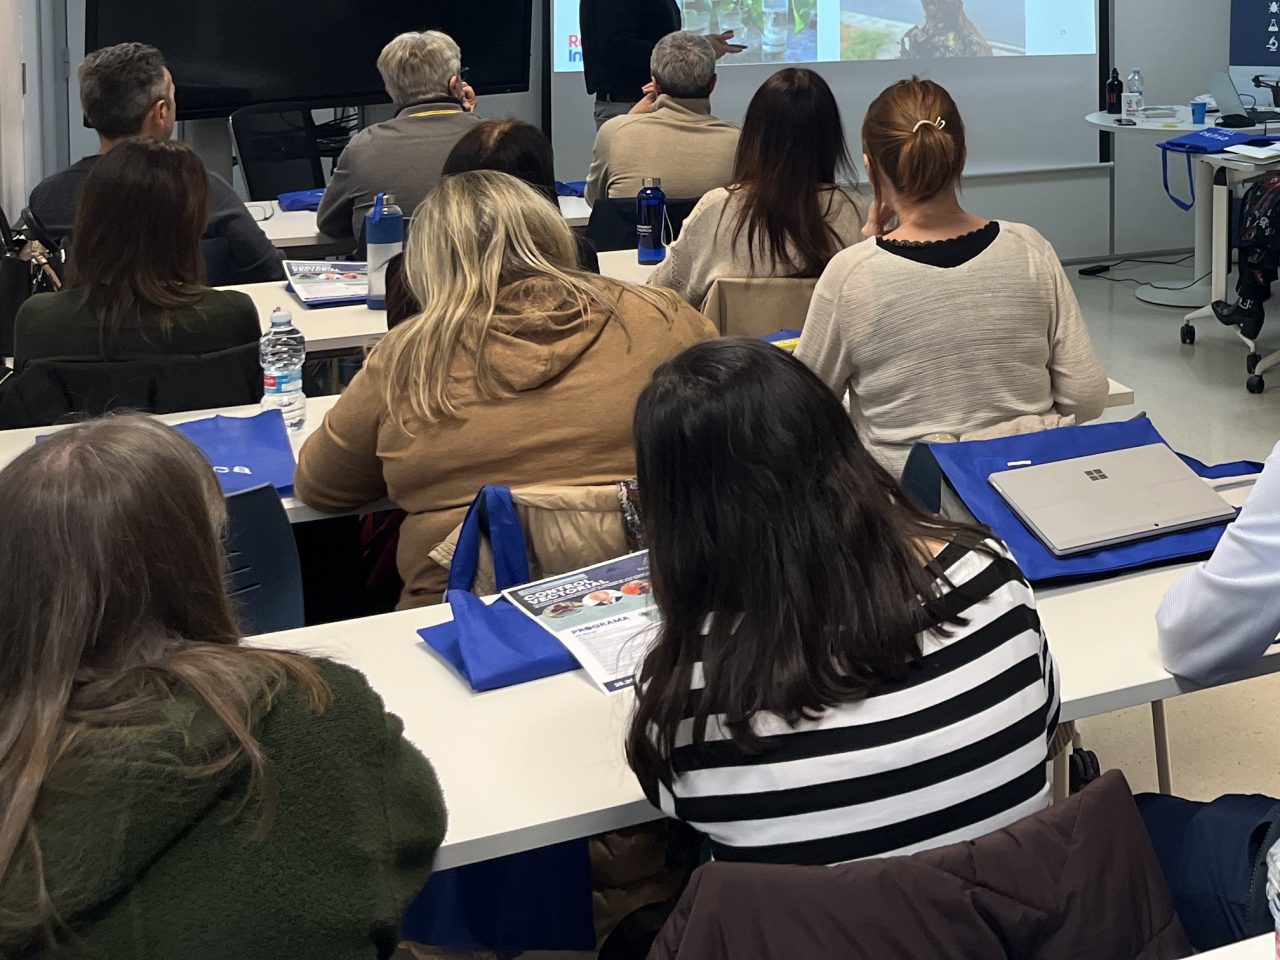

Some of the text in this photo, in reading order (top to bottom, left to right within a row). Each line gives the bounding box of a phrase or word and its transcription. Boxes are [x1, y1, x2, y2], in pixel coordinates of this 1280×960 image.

[524, 579, 595, 602] CONTROL
[527, 579, 611, 606] VECTORIAL
[571, 615, 631, 635] PROGRAMA
